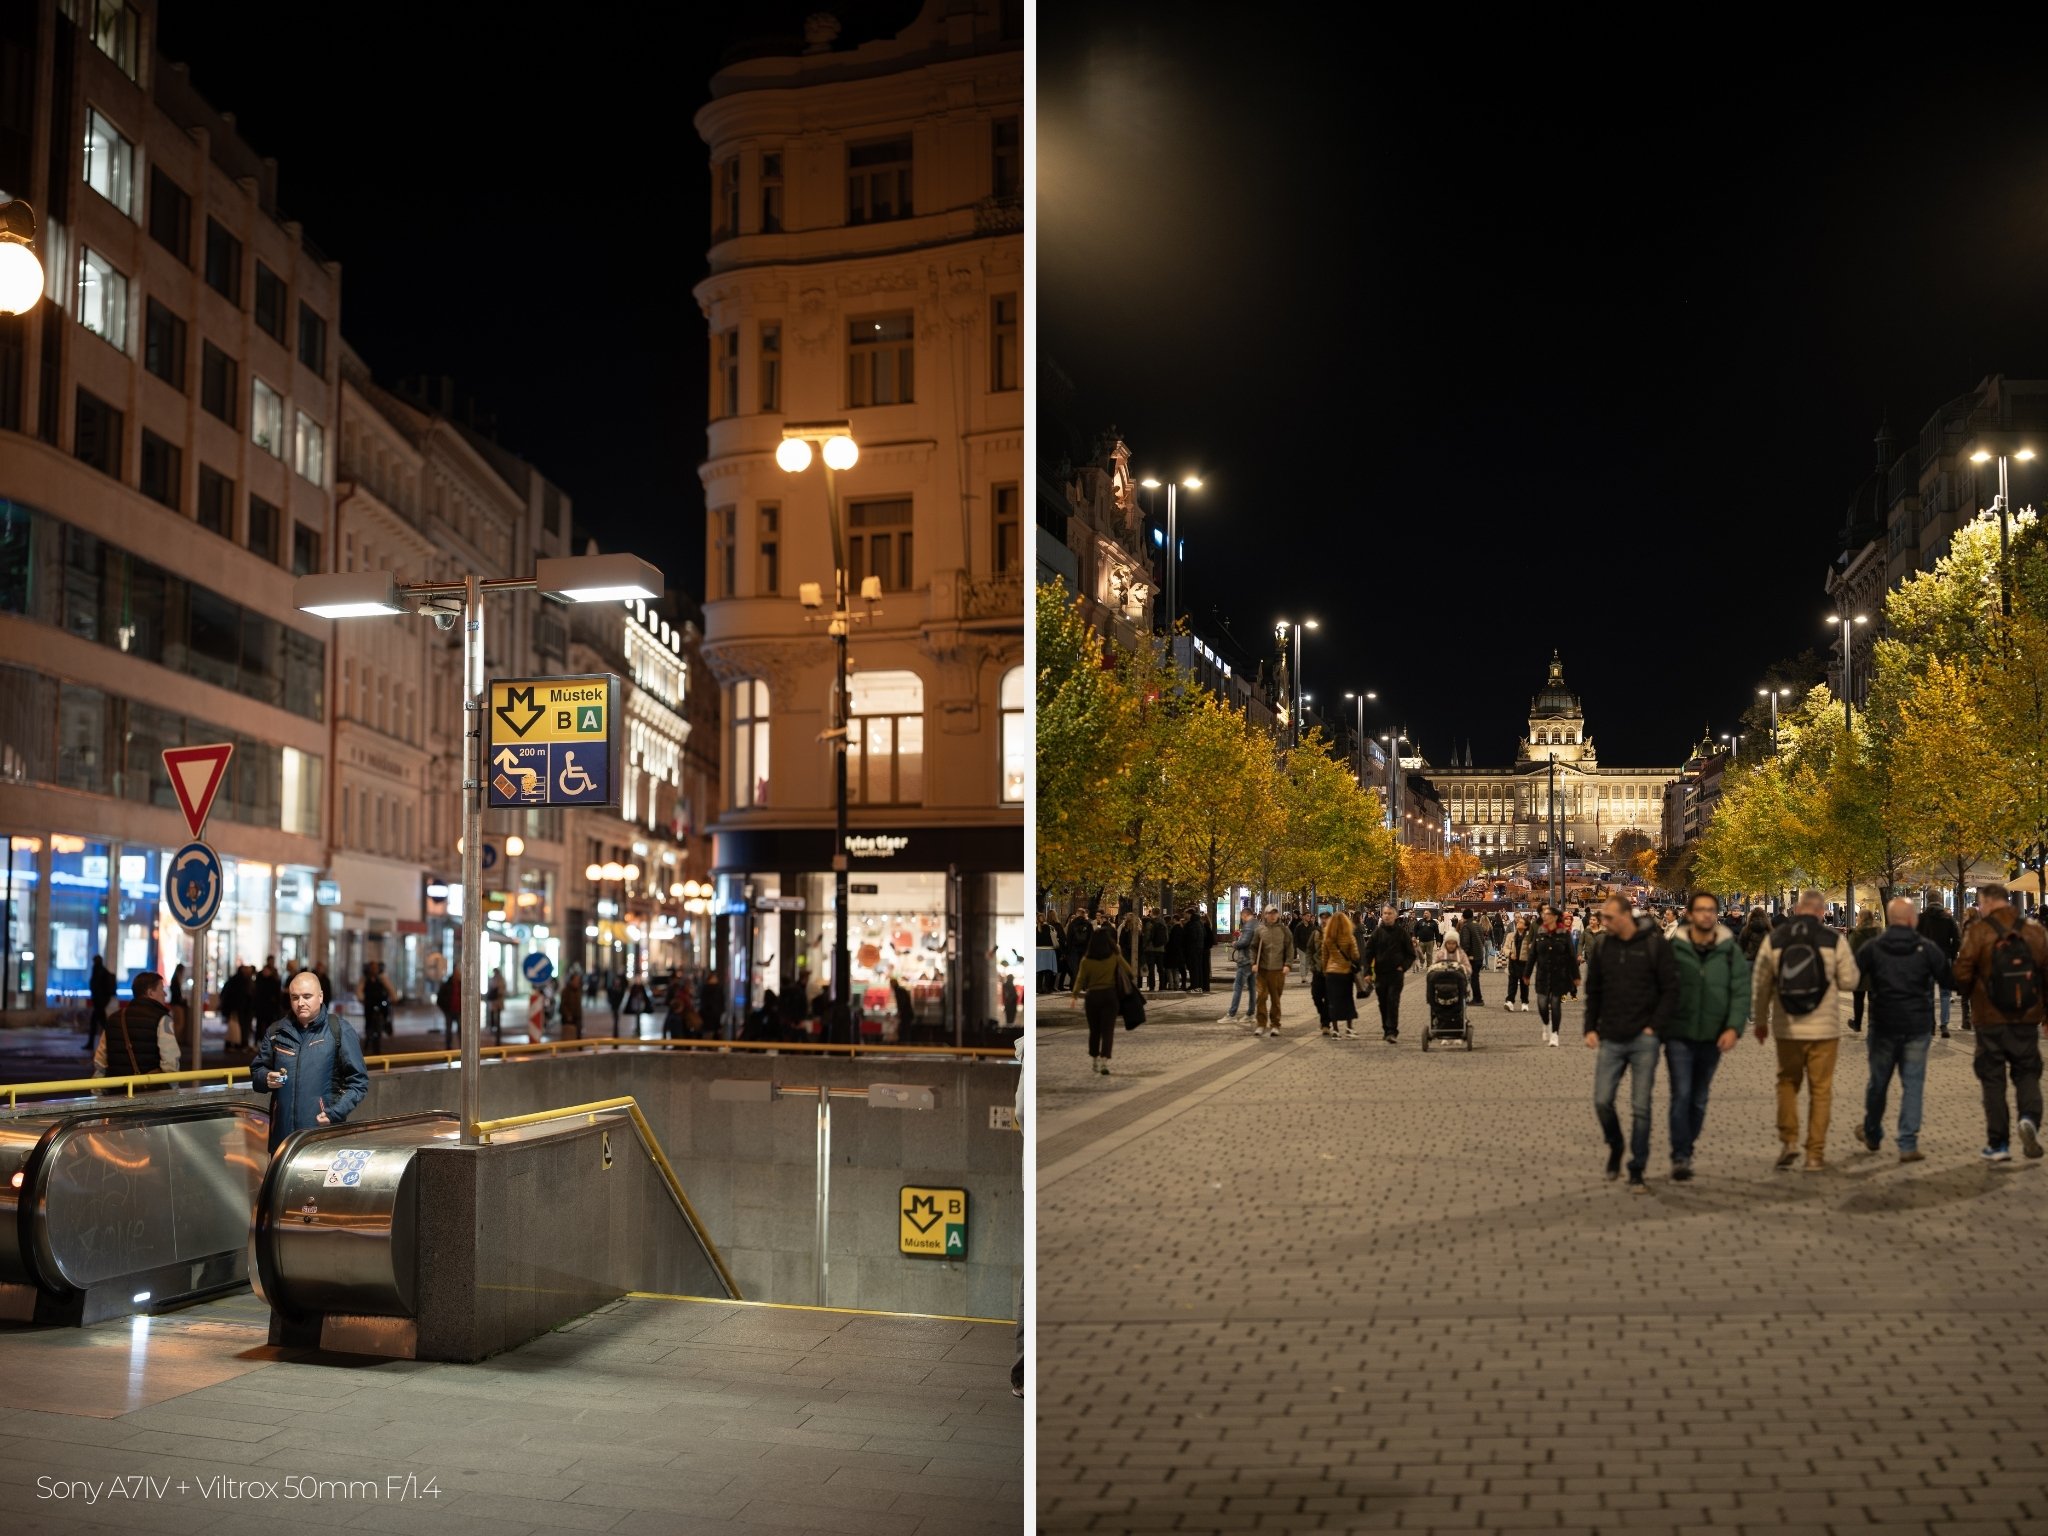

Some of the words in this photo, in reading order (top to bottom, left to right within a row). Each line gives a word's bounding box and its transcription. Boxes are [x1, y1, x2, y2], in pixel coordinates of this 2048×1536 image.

[557, 711, 572, 730] B
[581, 710, 599, 729] A
[519, 748, 535, 757] 200
[948, 1199, 962, 1214] B
[947, 1230, 962, 1248] A
